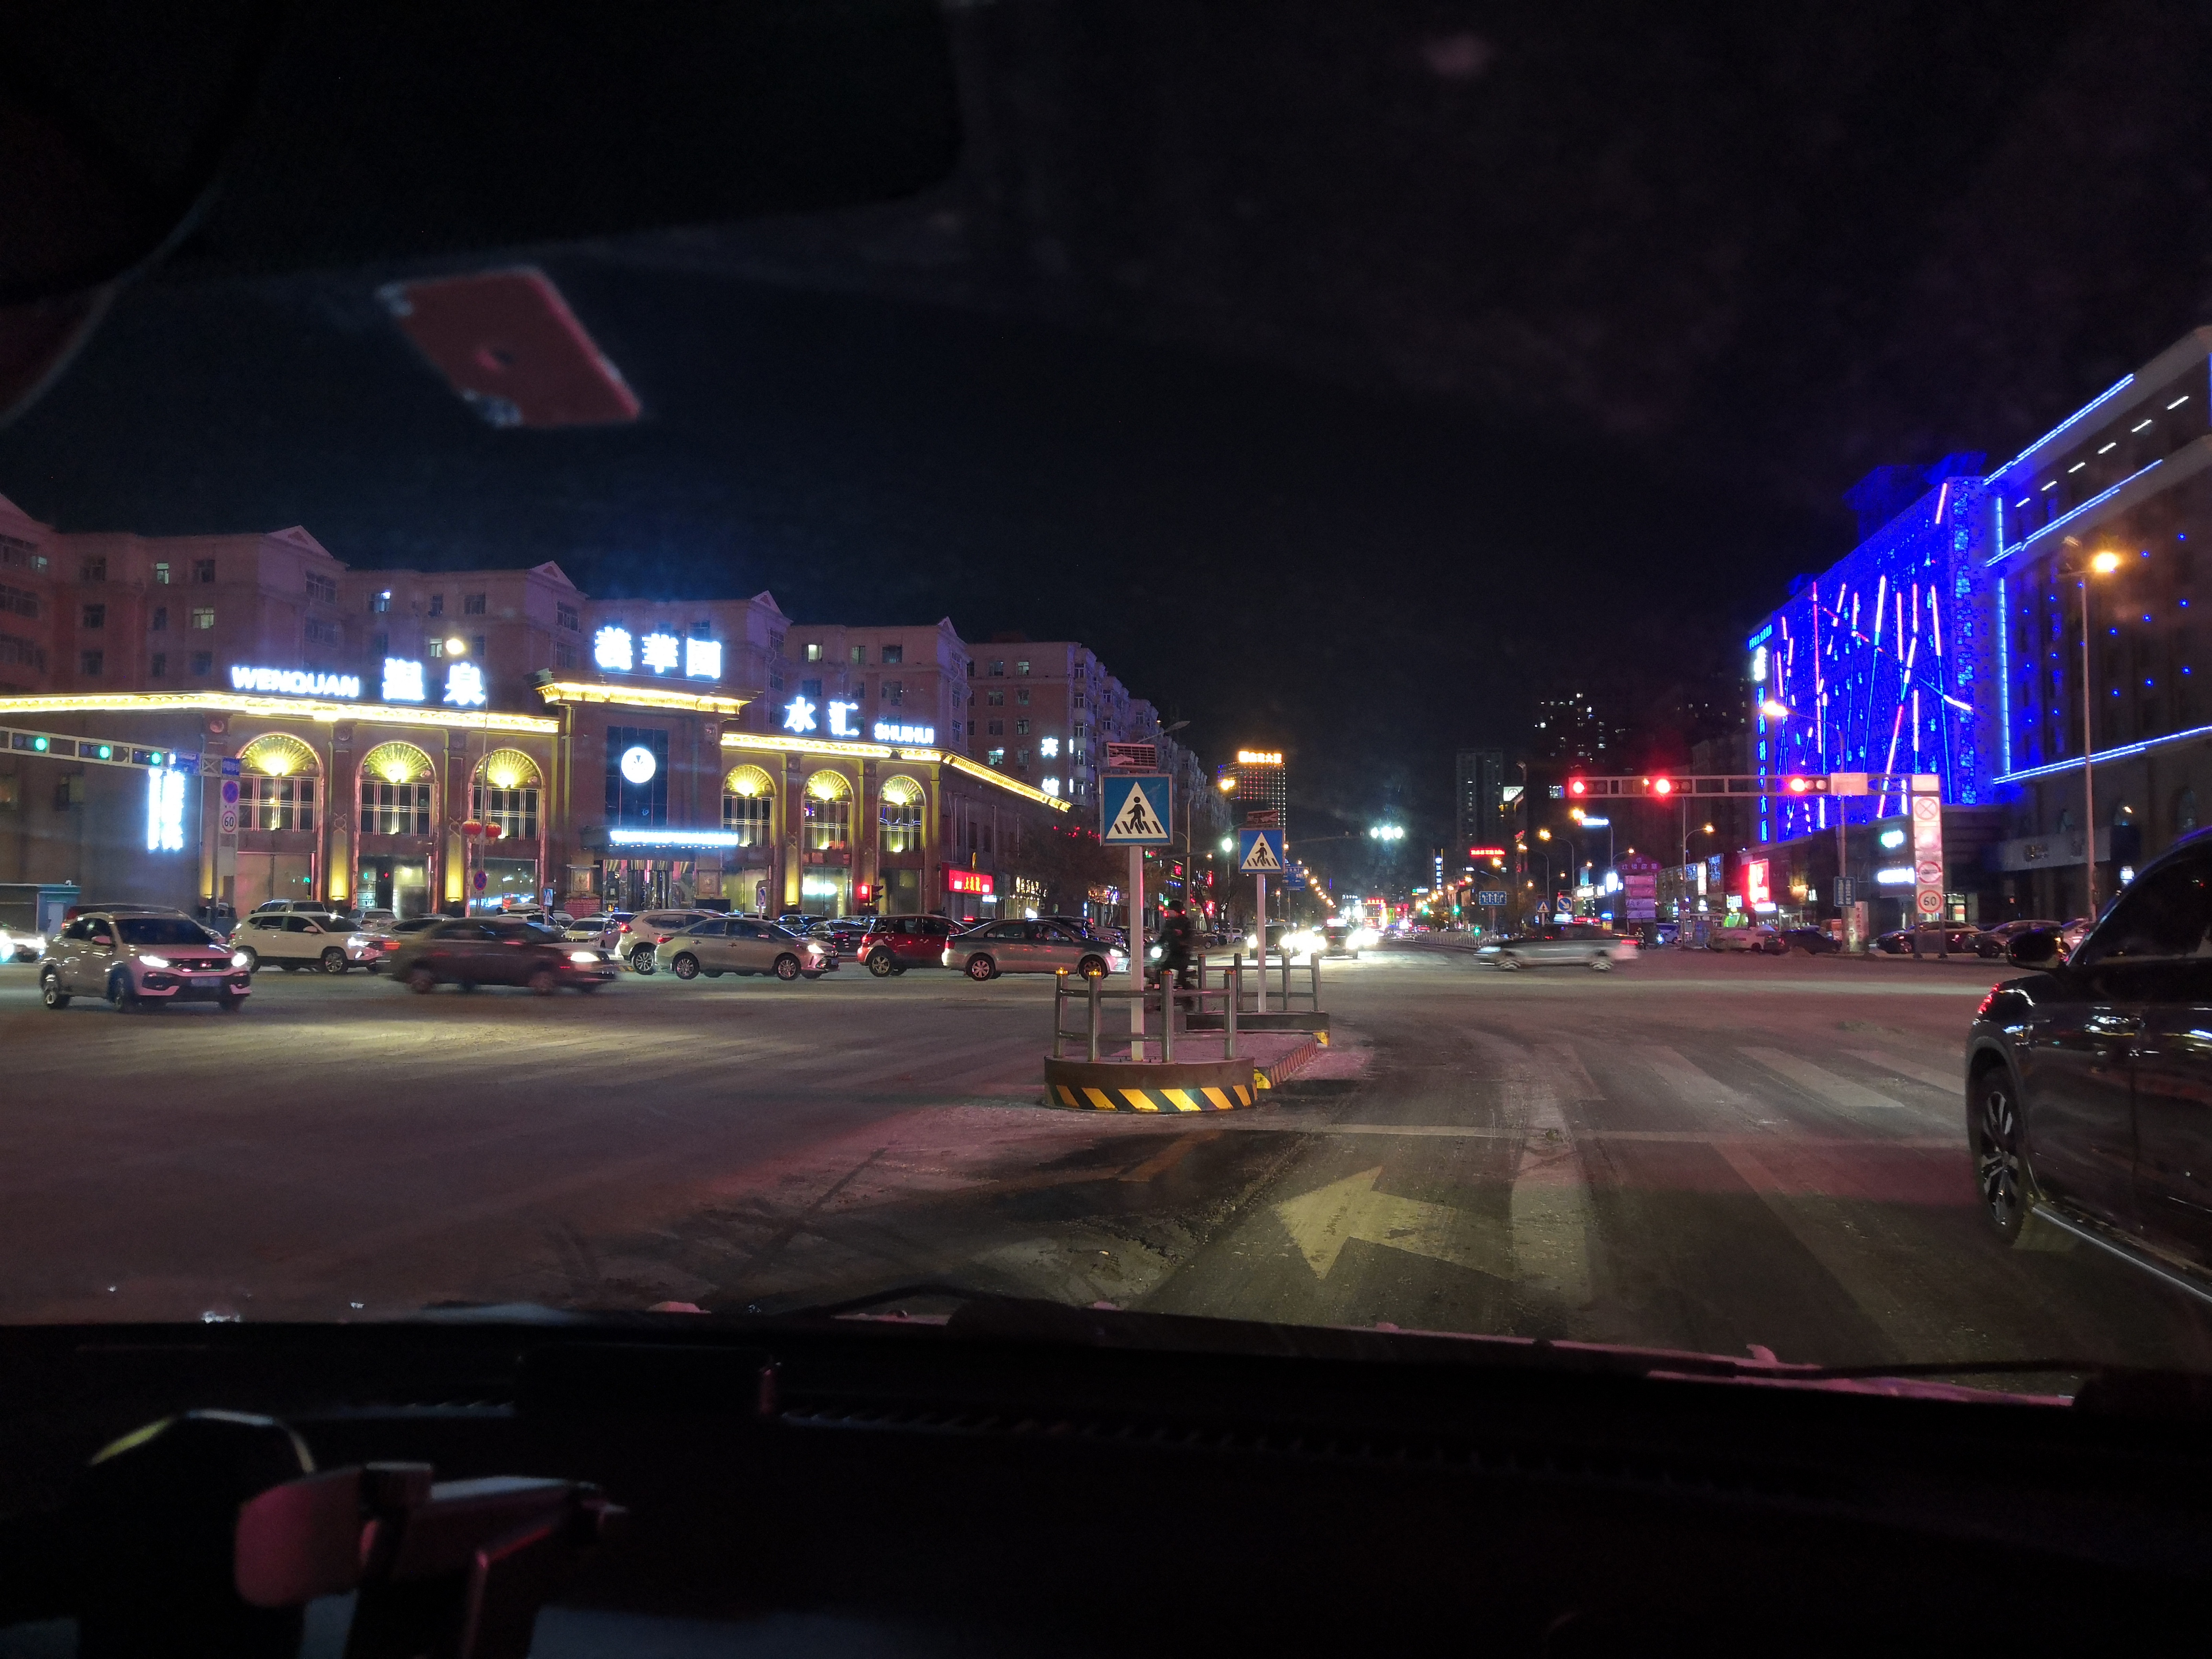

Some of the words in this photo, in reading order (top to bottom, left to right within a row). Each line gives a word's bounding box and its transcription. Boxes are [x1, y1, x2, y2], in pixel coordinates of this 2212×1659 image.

[231, 666, 360, 698] WENQUAN
[783, 696, 860, 736] 水汇
[874, 723, 934, 744] SHUIHUI
[224, 817, 234, 827] 60
[1923, 896, 1937, 906] 60
